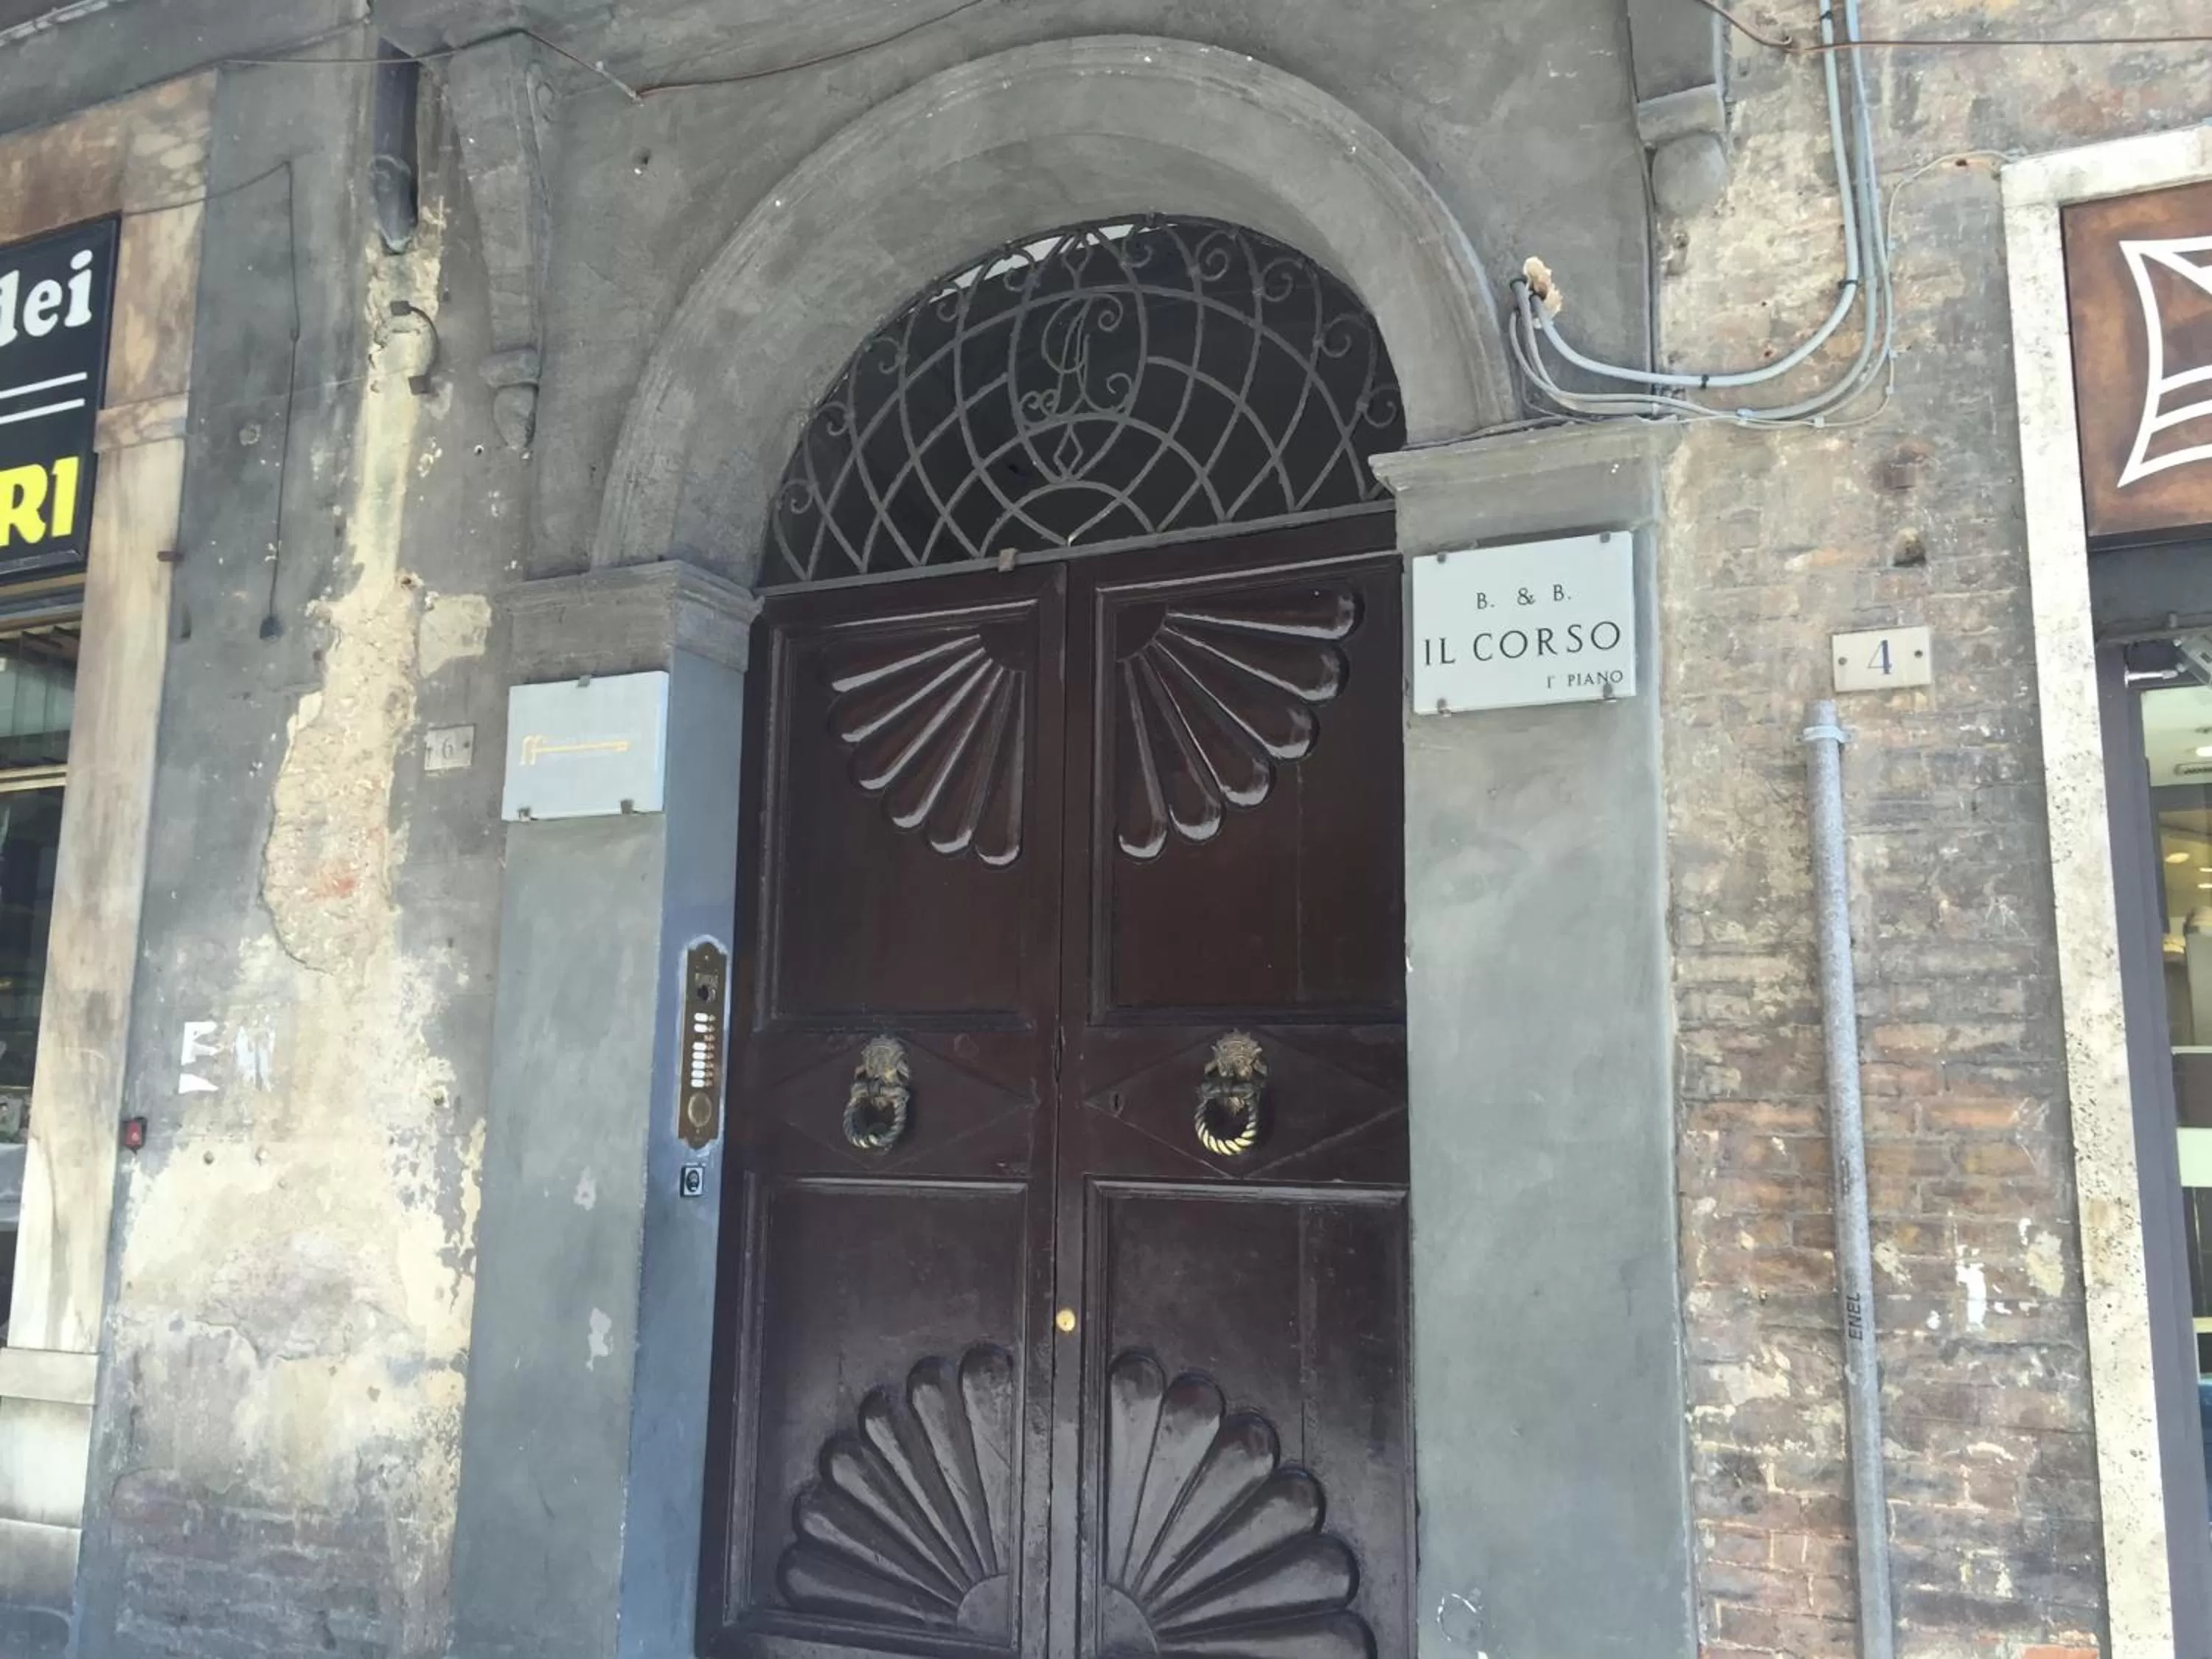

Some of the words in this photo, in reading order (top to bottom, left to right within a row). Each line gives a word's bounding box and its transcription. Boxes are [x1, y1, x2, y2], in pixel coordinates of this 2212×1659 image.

[1476, 592, 1495, 610] B.
[1517, 588, 1536, 606] &
[1553, 584, 1572, 602] B.
[1425, 636, 1456, 667] IL
[1473, 620, 1621, 662] CORSO
[1867, 639, 1892, 675] 4
[1567, 669, 1624, 687] PIANO
[1846, 1292, 1863, 1341] ENEL
